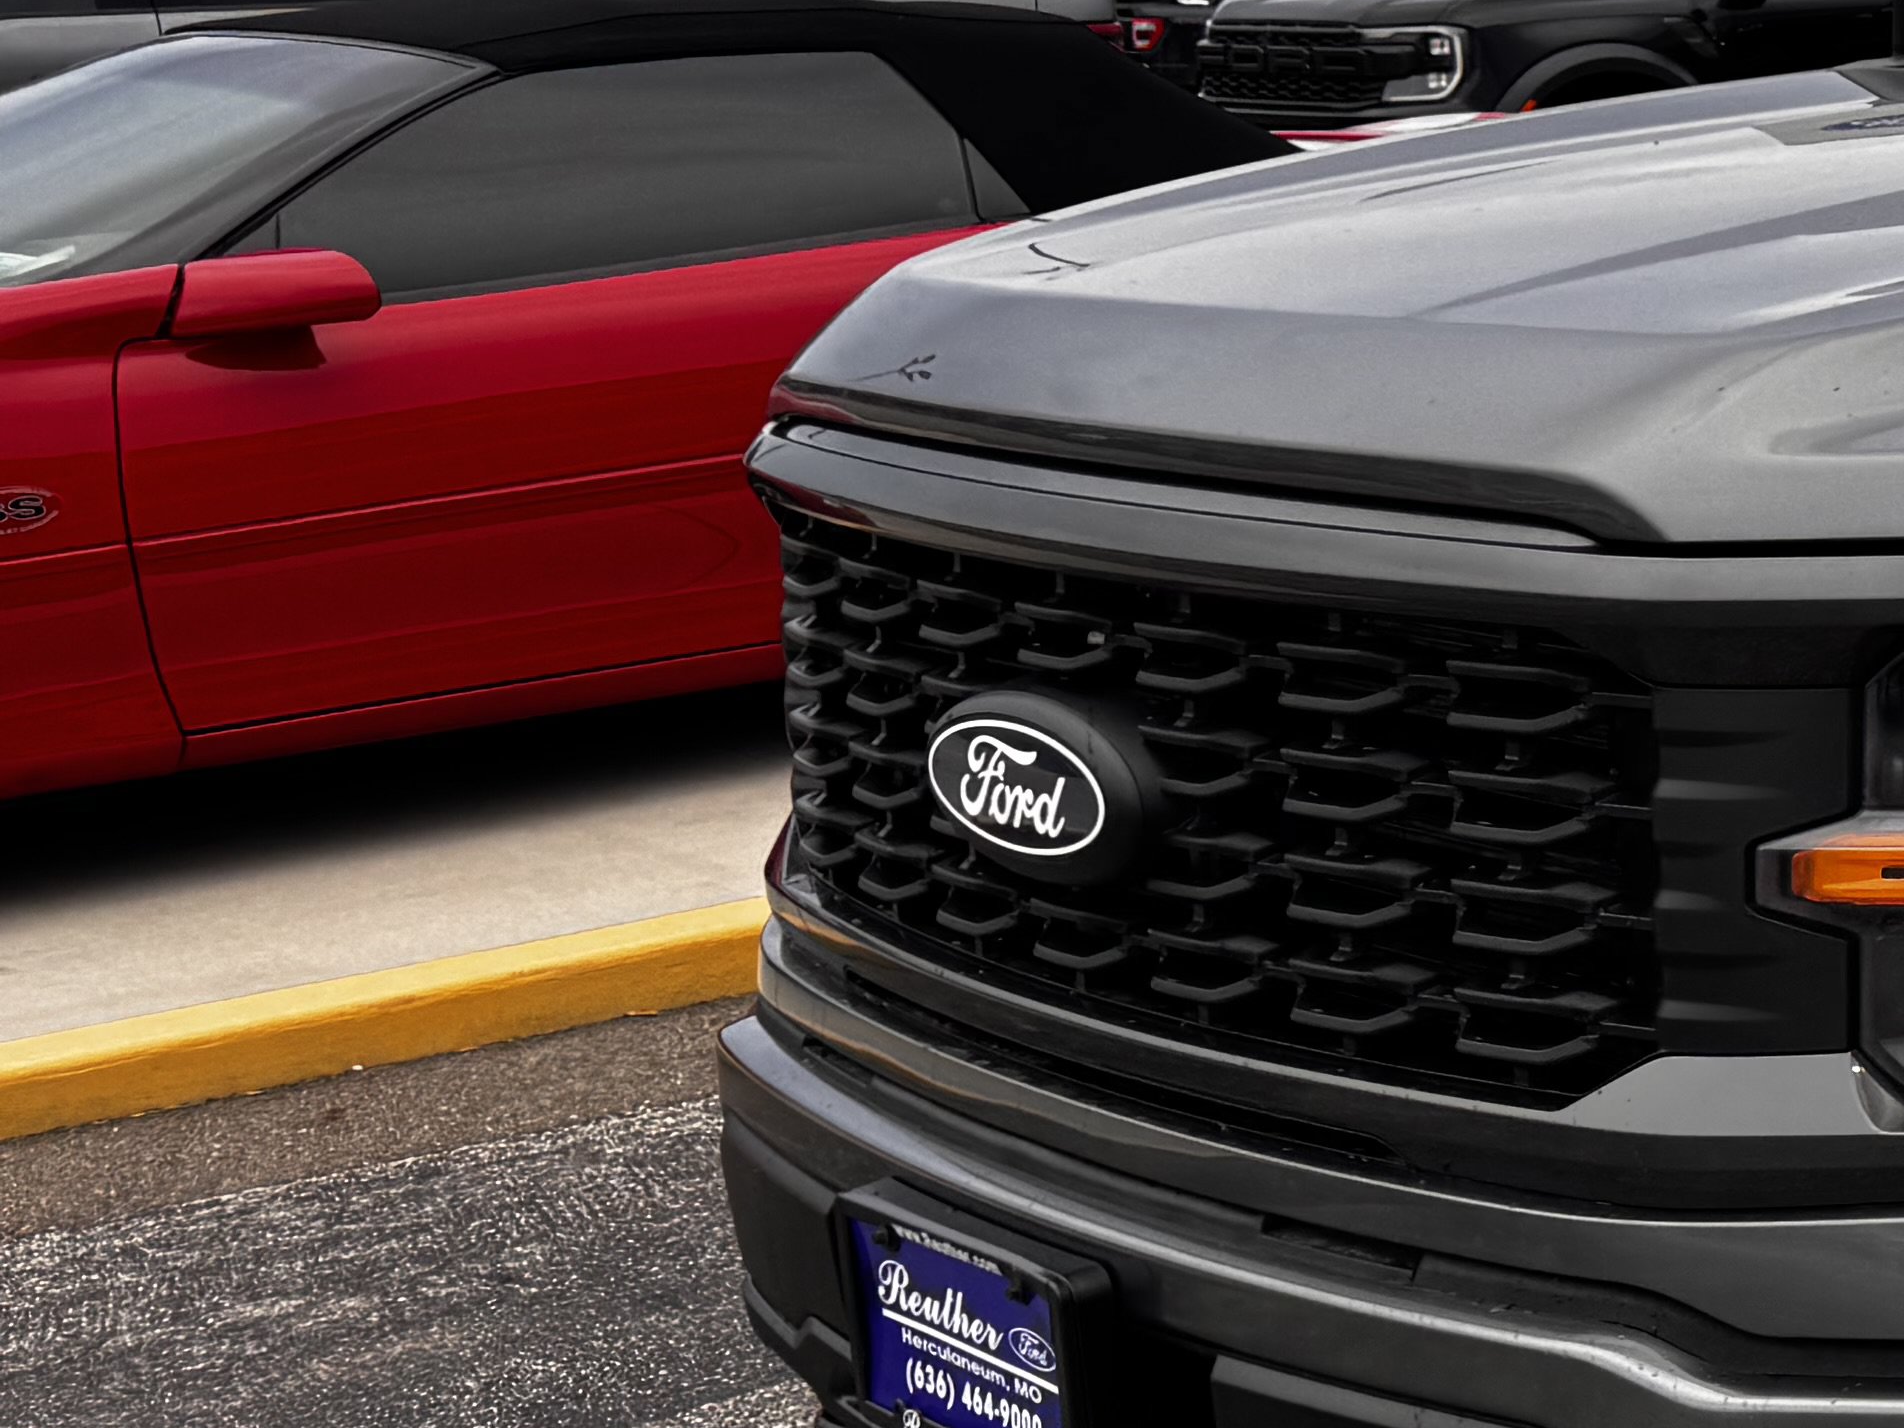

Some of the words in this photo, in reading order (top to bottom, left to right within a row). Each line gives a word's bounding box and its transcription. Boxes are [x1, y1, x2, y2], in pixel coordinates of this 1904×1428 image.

[960, 734, 1066, 838] Ford
[878, 1260, 1004, 1351] Reuther
[901, 1327, 1010, 1392] Herculaneum,
[1014, 1377, 1042, 1404] MO
[906, 1357, 956, 1411] (636)
